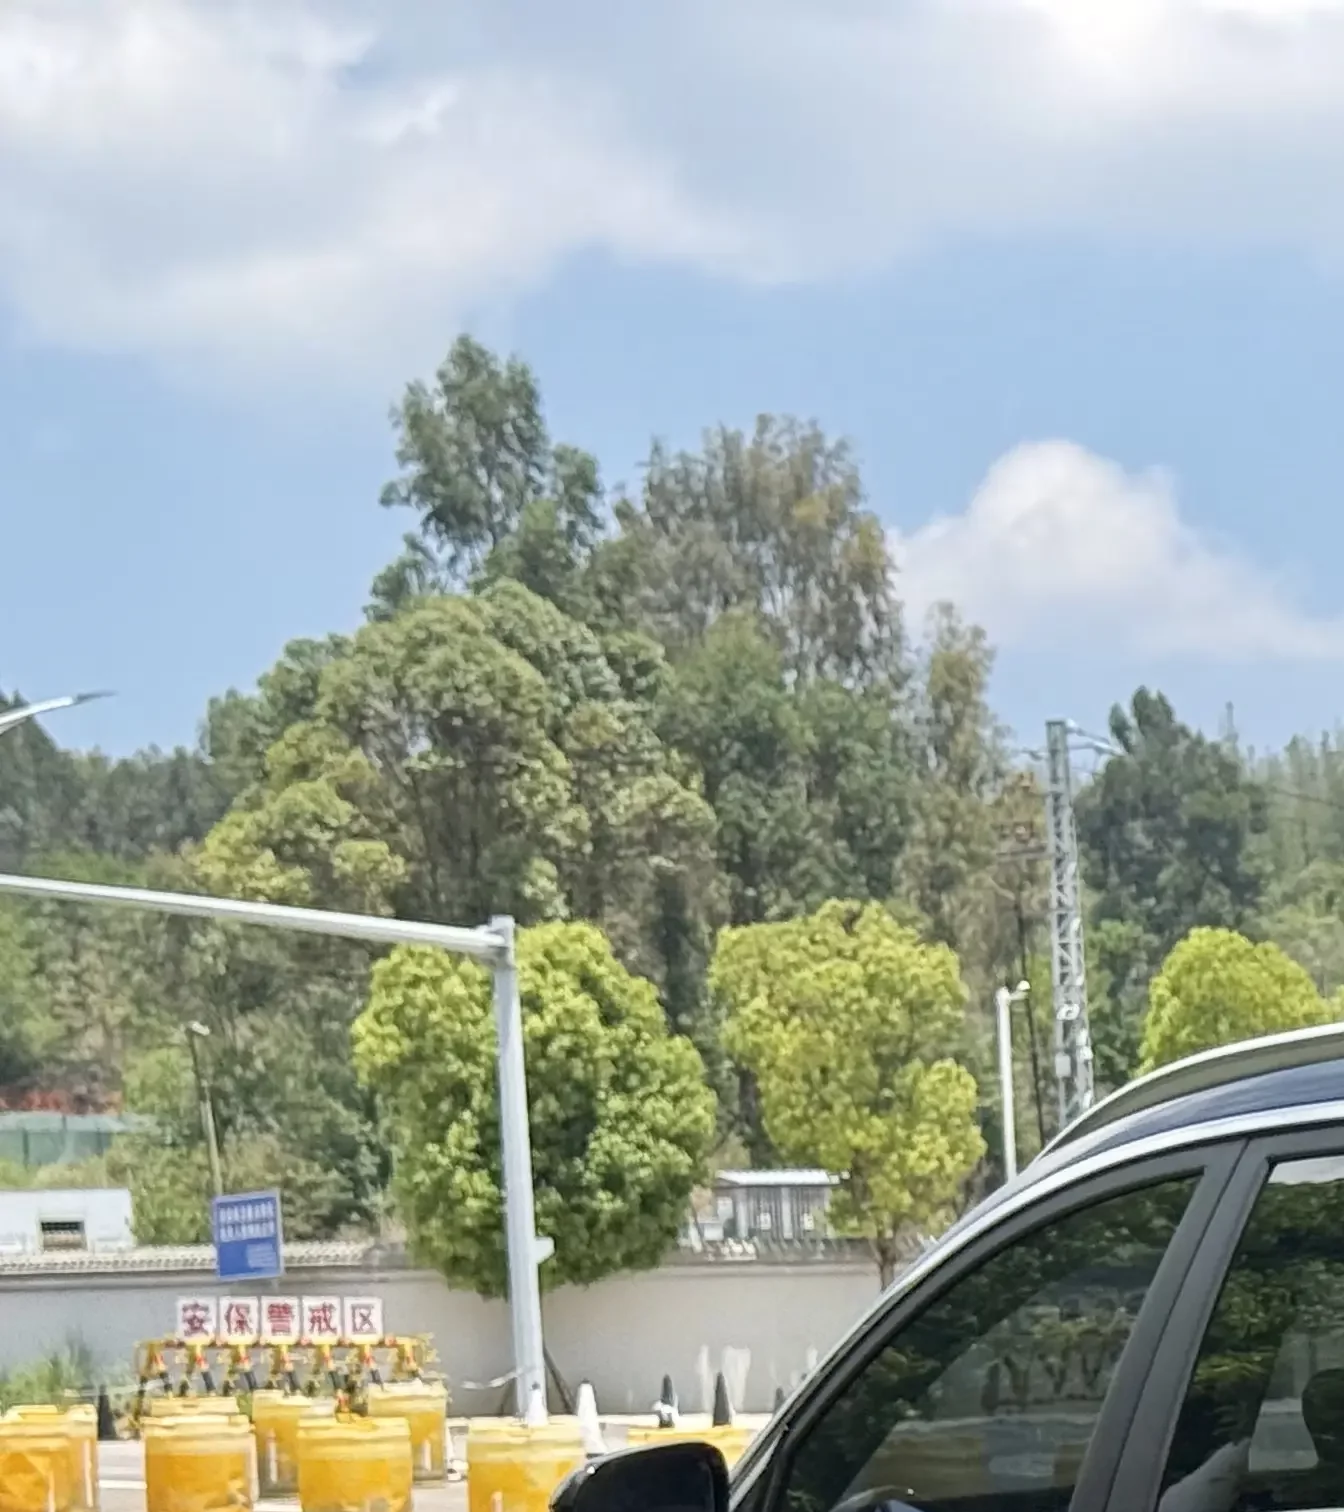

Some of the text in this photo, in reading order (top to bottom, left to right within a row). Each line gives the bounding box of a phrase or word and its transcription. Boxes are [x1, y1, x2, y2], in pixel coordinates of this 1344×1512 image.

[181, 1300, 377, 1337] 安保警戒区
